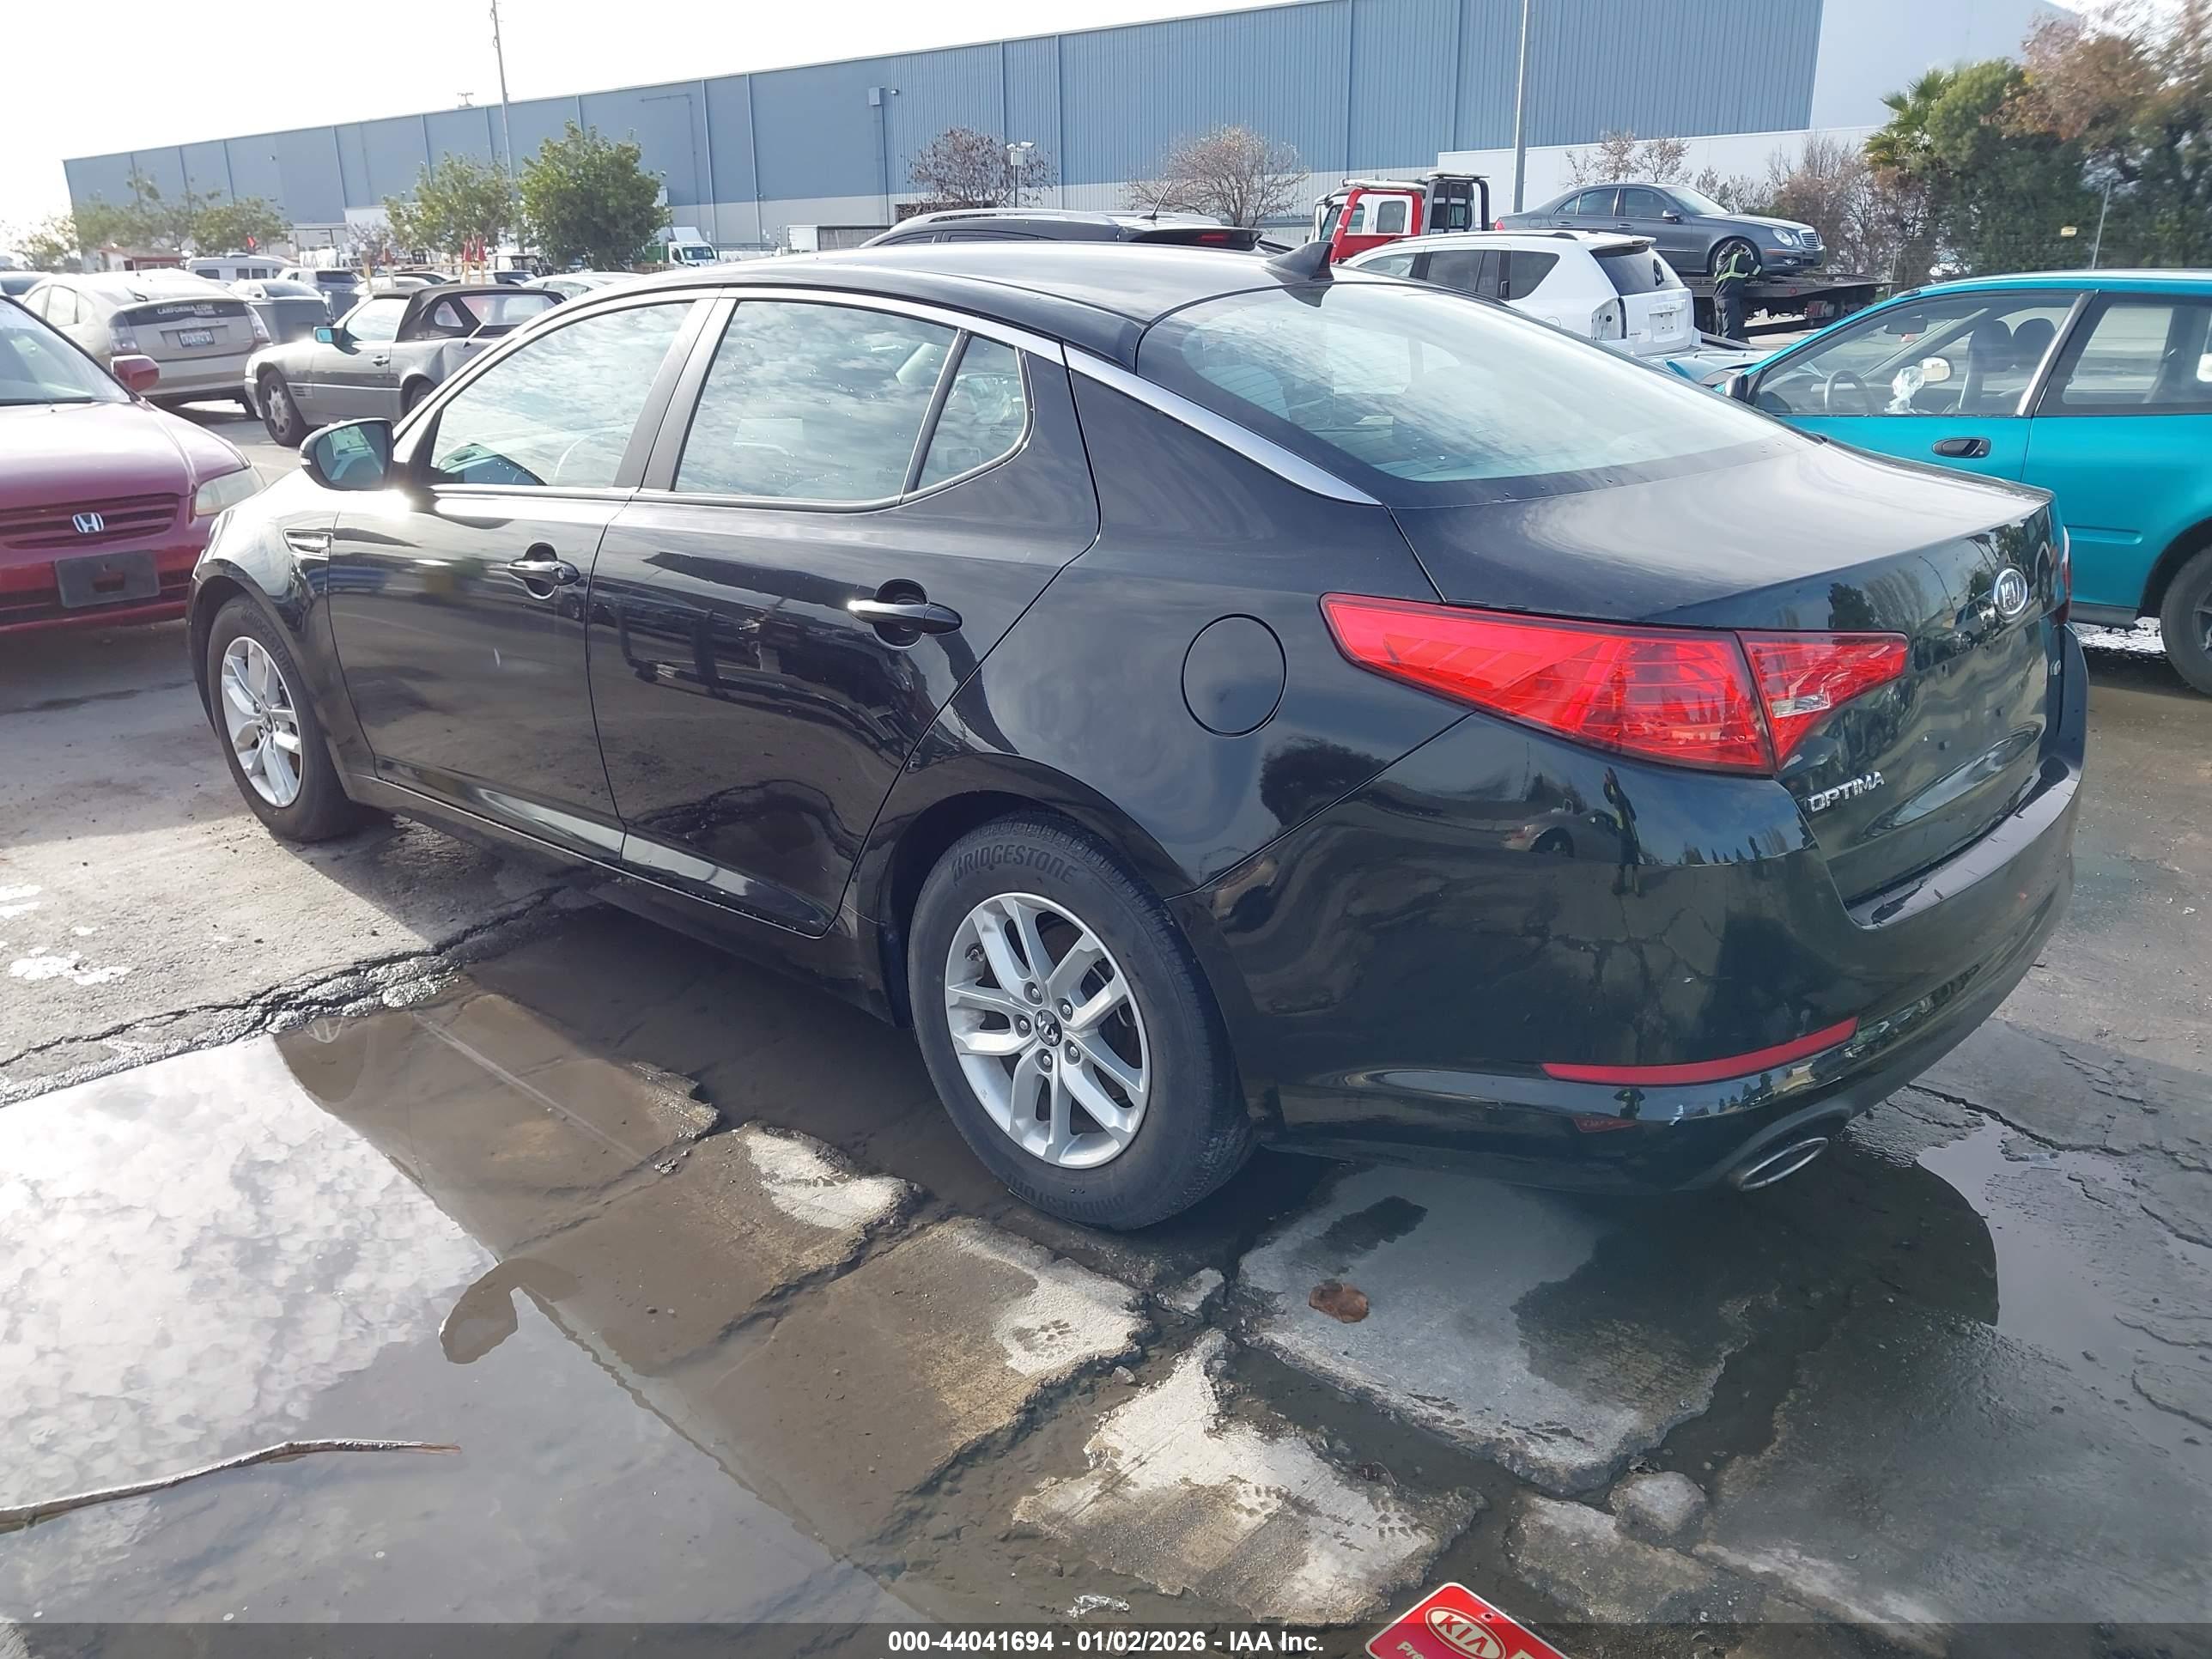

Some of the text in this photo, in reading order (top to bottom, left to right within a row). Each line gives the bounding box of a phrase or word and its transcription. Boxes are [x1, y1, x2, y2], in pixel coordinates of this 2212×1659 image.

[1808, 771, 1885, 812] OPTIMA
[951, 844, 1078, 886] BRIDGESTONE
[1437, 1614, 1489, 1655] KIA
